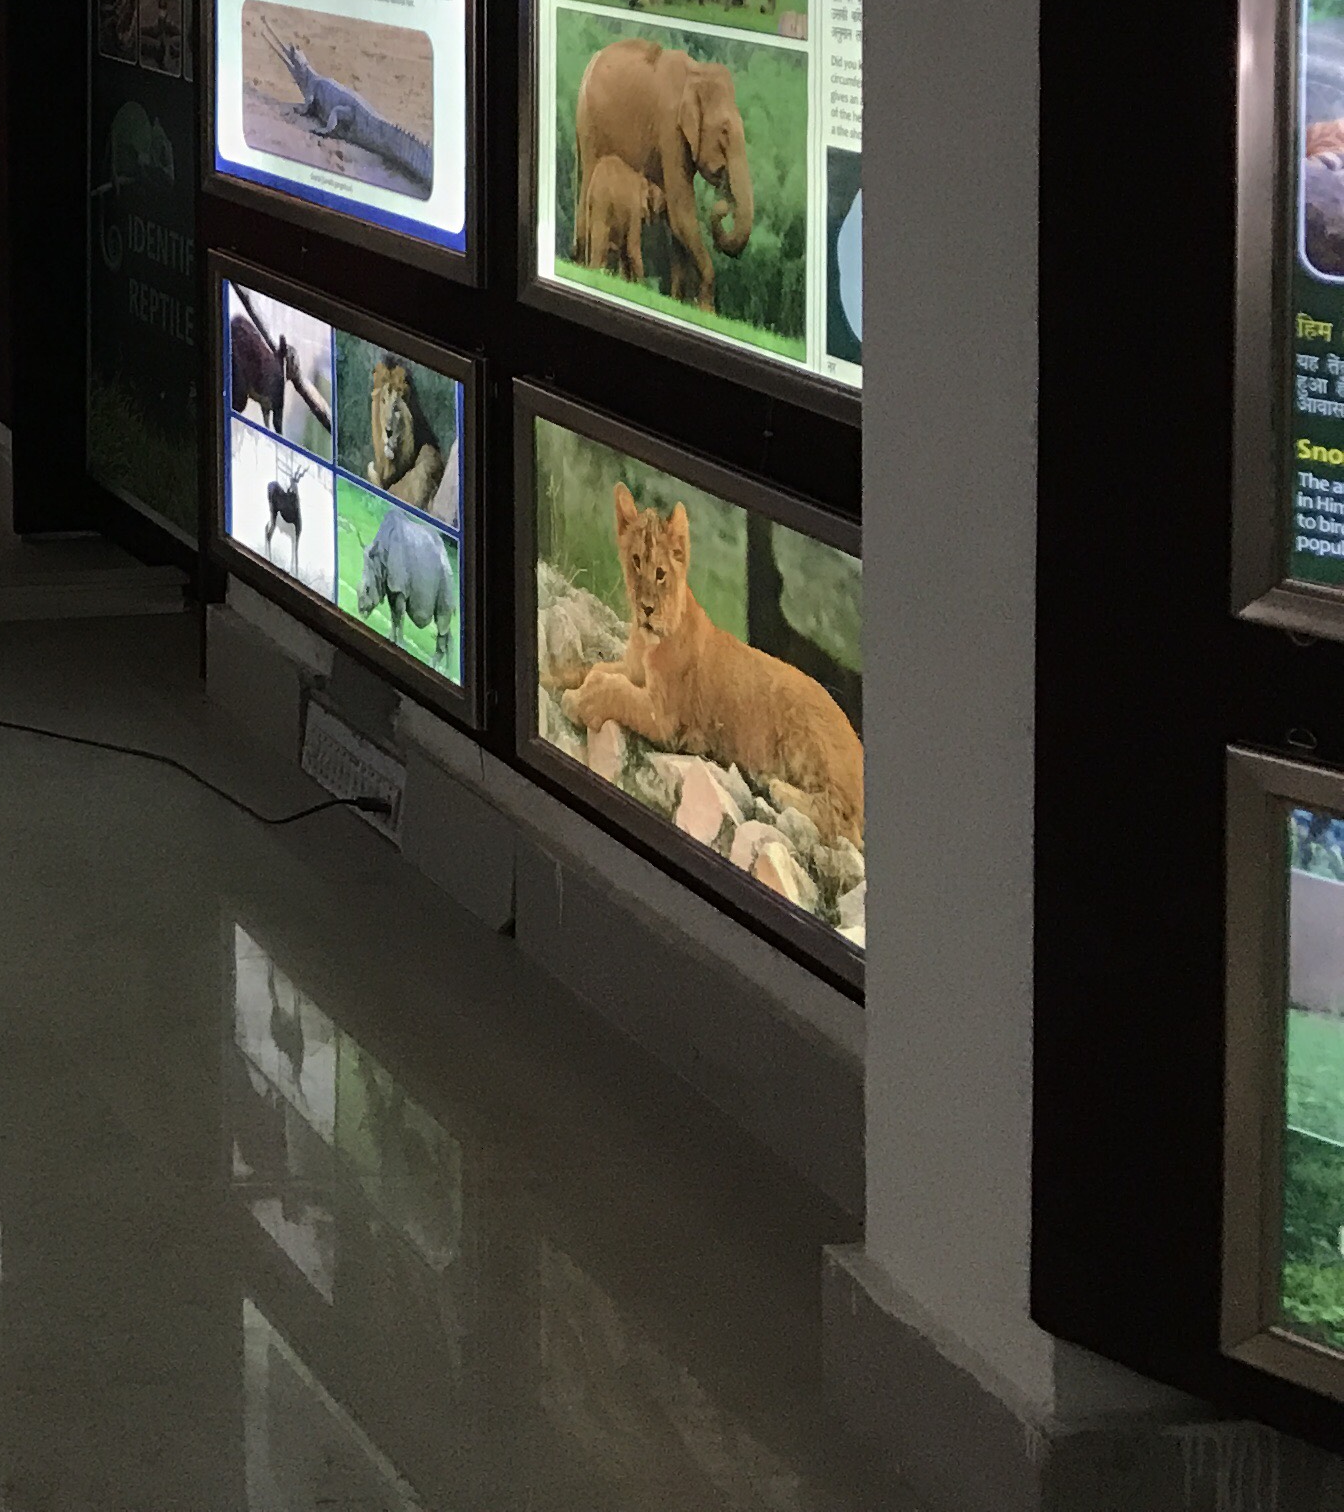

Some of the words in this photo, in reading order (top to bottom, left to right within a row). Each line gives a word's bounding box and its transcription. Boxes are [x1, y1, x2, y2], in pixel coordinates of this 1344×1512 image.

[831, 55, 843, 67] Did
[1297, 312, 1333, 342] हिम
[1296, 353, 1319, 373] यह
[1297, 374, 1329, 398] हुआ
[1297, 439, 1344, 465] Sno
[1299, 471, 1330, 494] The
[1298, 492, 1313, 511] in
[1298, 513, 1317, 531] to
